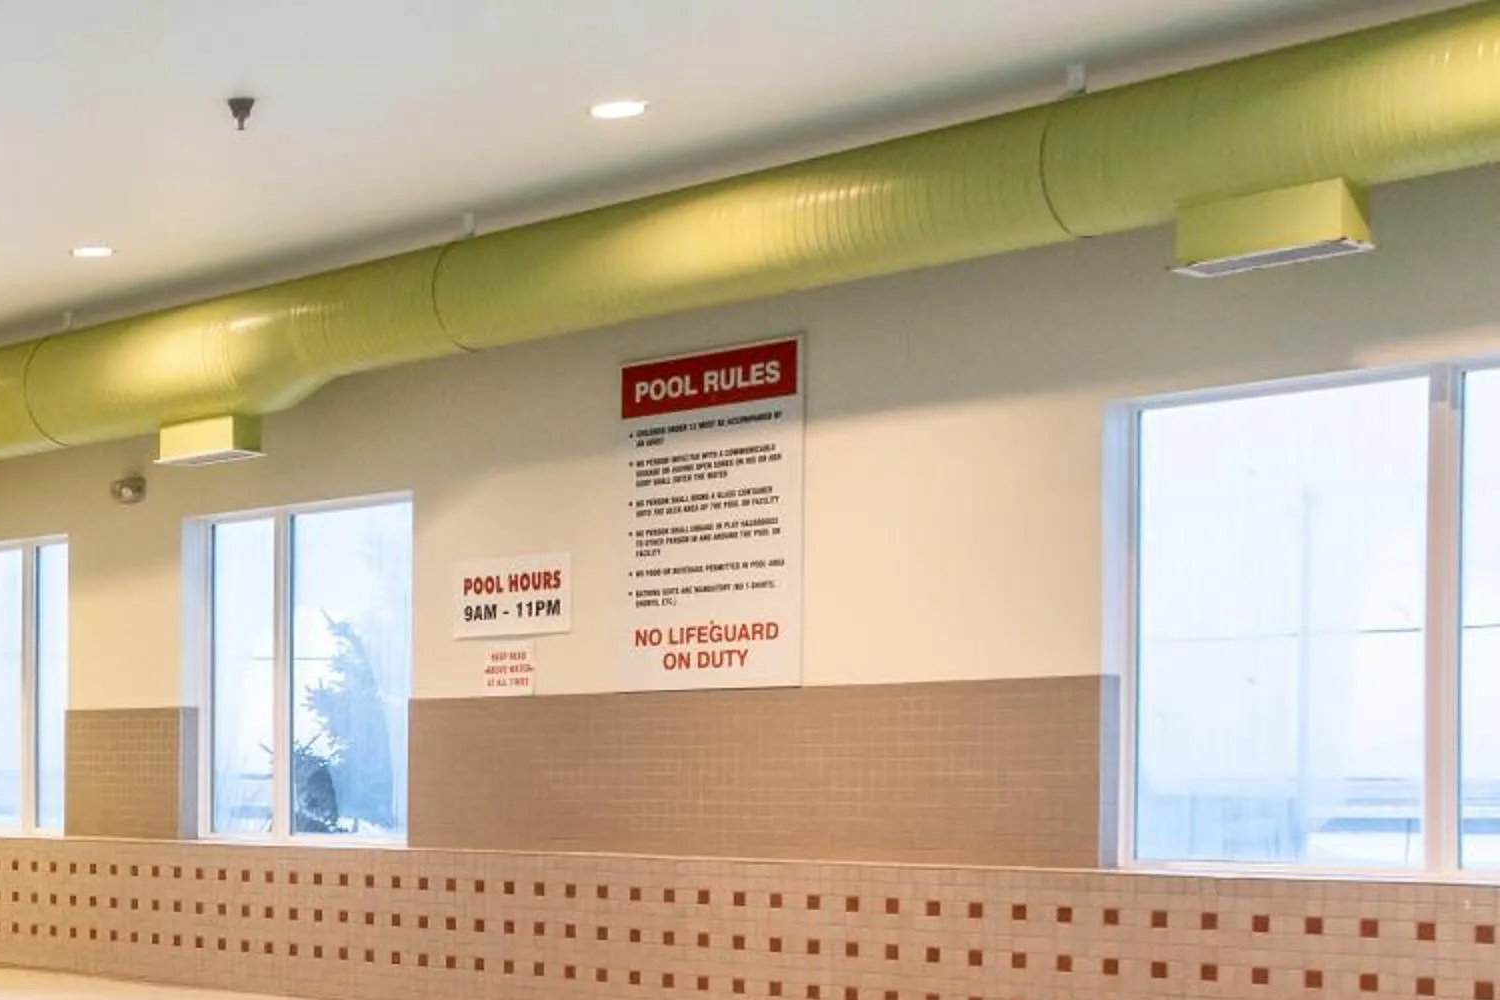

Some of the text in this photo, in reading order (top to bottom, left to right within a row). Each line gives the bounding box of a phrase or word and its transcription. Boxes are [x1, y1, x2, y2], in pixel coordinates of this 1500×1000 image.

[634, 360, 781, 403] POOL RULES
[463, 570, 562, 596] POOL HOURS
[463, 603, 498, 622] 9AM
[516, 598, 562, 618] 11PM
[635, 621, 779, 647] NO LIFEGUARD
[663, 649, 749, 671] ON DUTY
